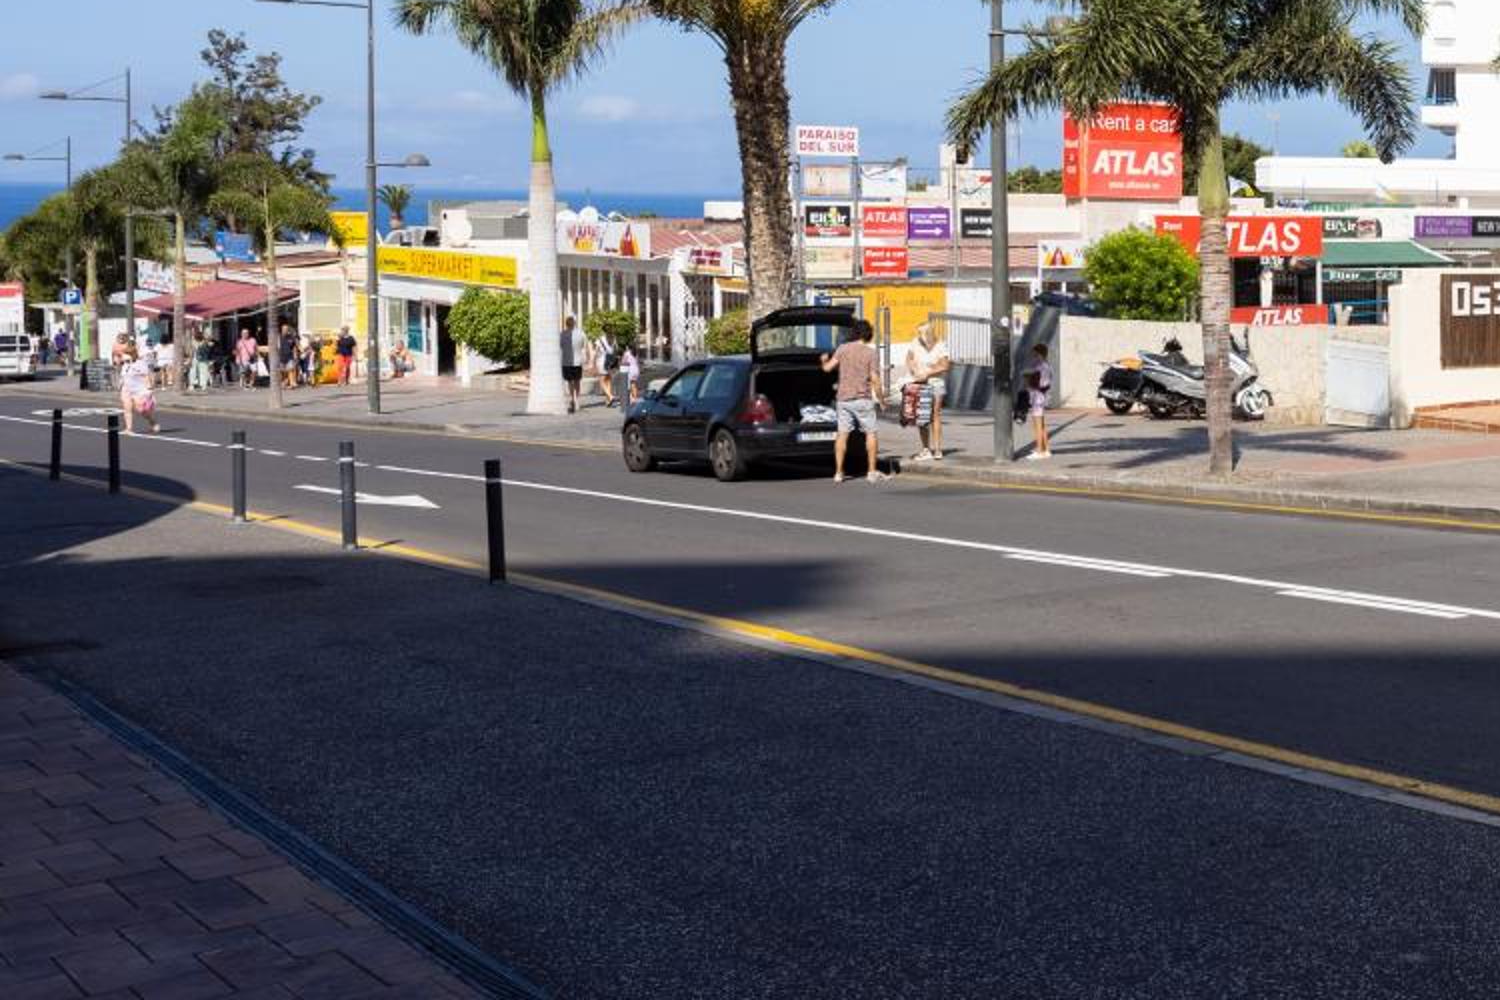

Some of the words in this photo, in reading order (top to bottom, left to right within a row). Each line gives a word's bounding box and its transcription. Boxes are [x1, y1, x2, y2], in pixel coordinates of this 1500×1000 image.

[1091, 111, 1131, 132] Rent
[1135, 118, 1145, 132] a
[799, 128, 856, 140] PARAISO
[799, 141, 822, 152] DEL
[829, 141, 855, 153] SUR
[1091, 148, 1177, 177] ATLAS
[865, 211, 905, 223] ATLAS
[1195, 221, 1301, 253] TLAS
[409, 251, 473, 280] SUPERMARKET
[1252, 309, 1303, 327] ATLAS
